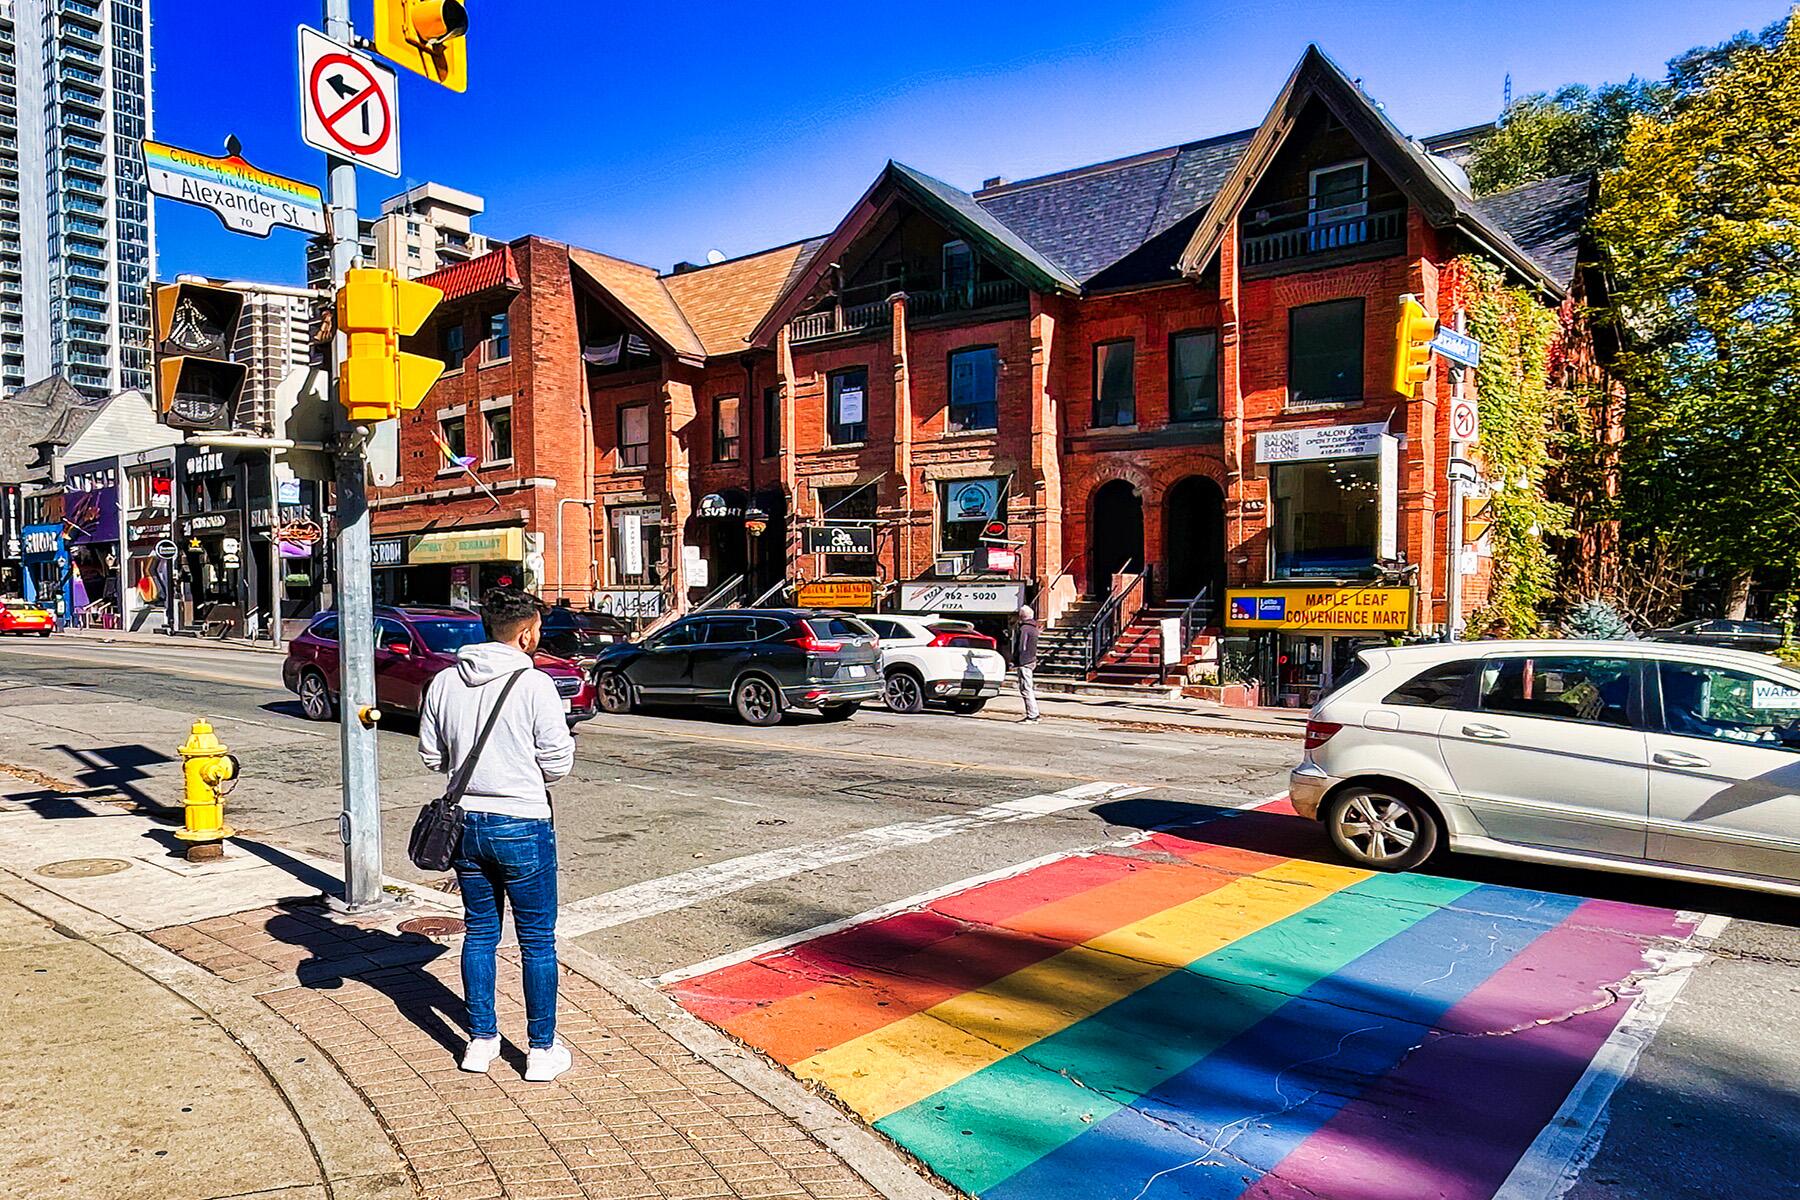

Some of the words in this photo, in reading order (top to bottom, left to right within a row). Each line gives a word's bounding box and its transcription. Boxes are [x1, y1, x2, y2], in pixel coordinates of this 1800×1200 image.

[170, 150, 222, 174] CHURCH
[235, 167, 300, 195] WELLESLEY
[217, 175, 262, 194] VILLAGE
[182, 178, 276, 218] Alexander
[282, 203, 304, 226] St.
[240, 217, 253, 228] 70
[1317, 429, 1346, 438] SALON
[1348, 427, 1368, 436] ONE
[379, 543, 401, 562] ROOM
[973, 592, 997, 600] 5020
[1306, 593, 1349, 606] MAPLE
[1355, 593, 1388, 606] LEAF
[1286, 610, 1367, 625] CONVENIENCE
[1372, 611, 1407, 625] MART
[1756, 686, 1799, 698] WARD
